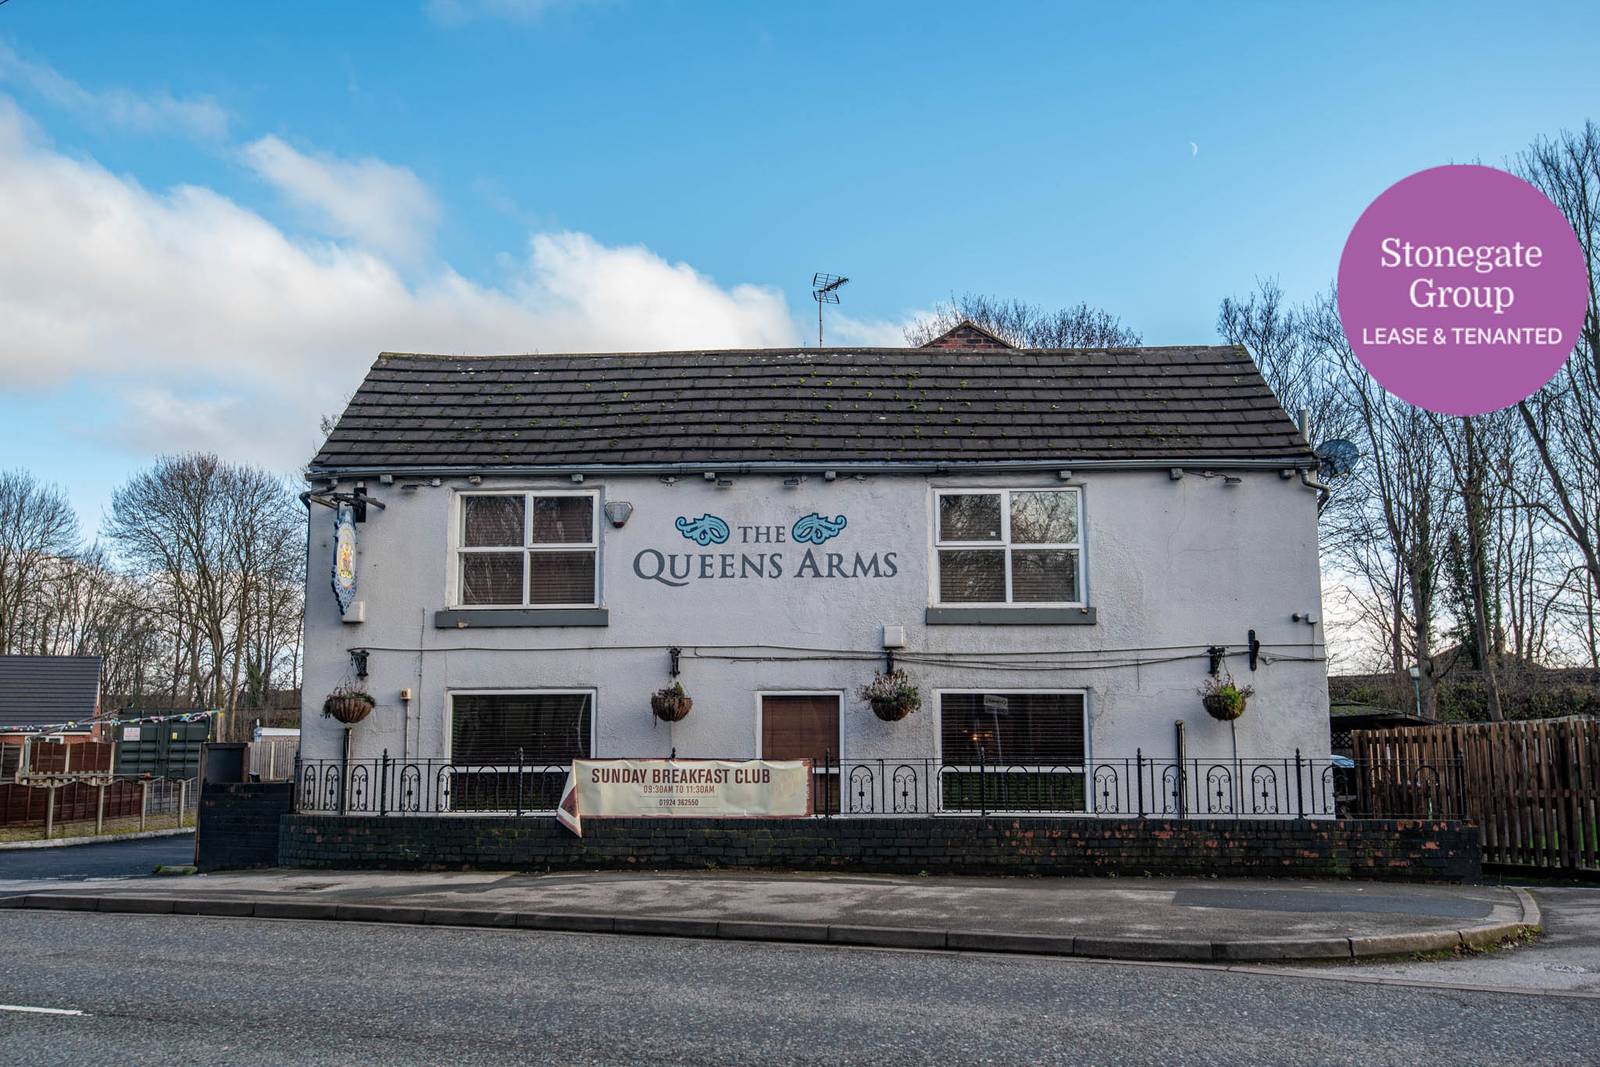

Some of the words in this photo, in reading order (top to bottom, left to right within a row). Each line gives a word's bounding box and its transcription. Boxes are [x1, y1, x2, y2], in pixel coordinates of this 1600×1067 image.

[737, 525, 787, 544] THE
[633, 548, 783, 587] QUEENS
[794, 547, 898, 578] ARMS
[591, 768, 648, 784] SUNDAY
[652, 768, 730, 784] BREAKFAST
[735, 768, 771, 784] CLUB
[643, 785, 674, 794] 09:30AM
[675, 785, 684, 794] TO
[686, 785, 715, 794] 11:30AM
[658, 799, 676, 807] 01924
